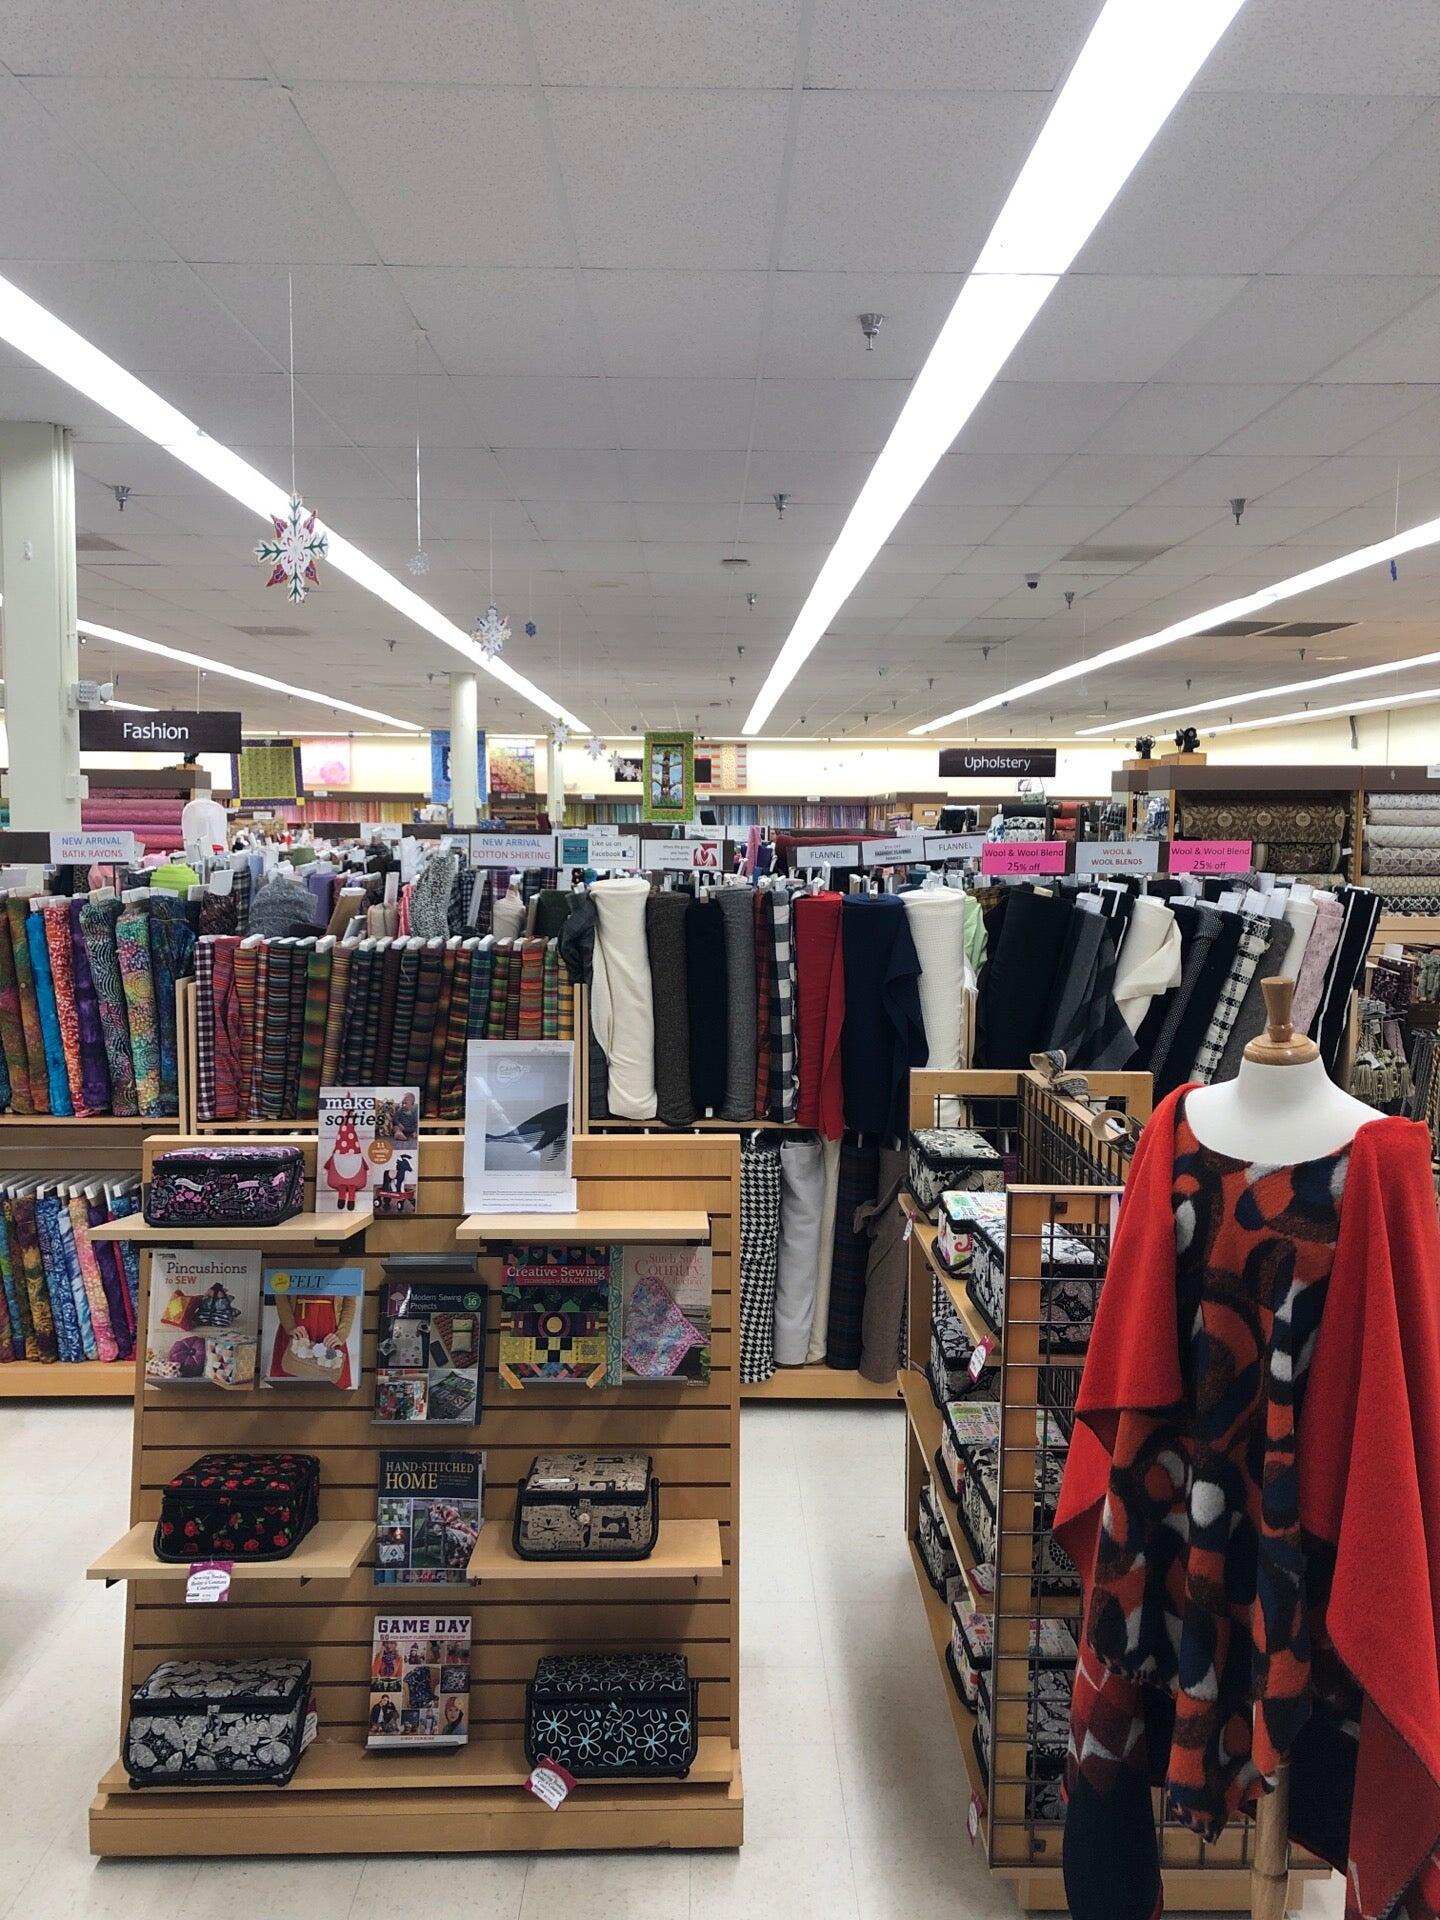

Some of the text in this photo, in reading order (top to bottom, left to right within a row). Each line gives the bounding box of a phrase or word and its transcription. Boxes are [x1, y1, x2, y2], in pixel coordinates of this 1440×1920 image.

[123, 722, 189, 740] Fashion
[964, 755, 1031, 771] Upholstery
[62, 837, 122, 845] NEW ARRIVAL
[482, 838, 542, 848] NEW ARRIVAL
[938, 842, 973, 851] FLANNEL
[1171, 847, 1193, 855] Wool
[1227, 847, 1250, 855] Blend
[62, 850, 123, 858] BATIK RAYONS
[472, 850, 551, 860] COTTON SHIRTING
[591, 849, 620, 857] Facebook
[810, 850, 845, 859] FLANNEL
[985, 848, 1064, 857] Wool & Wool Blend
[1007, 862, 1040, 871] 25% off
[1193, 860, 1226, 869] 25% off
[325, 1092, 375, 1110] make
[325, 1111, 386, 1126] softies
[166, 1261, 248, 1275] Pincushions
[507, 1265, 606, 1281] Creative Sewing
[165, 1275, 198, 1285] to SEW
[288, 1275, 325, 1289] FELT
[561, 1276, 599, 1284] MACHINE
[410, 1293, 462, 1303] Modern Sewing
[468, 1297, 477, 1306] 16
[410, 1302, 438, 1310] Projects
[385, 1461, 475, 1474] HAND-STITCHED
[384, 1472, 438, 1490] HOME
[378, 1619, 470, 1633] GAME DAY
